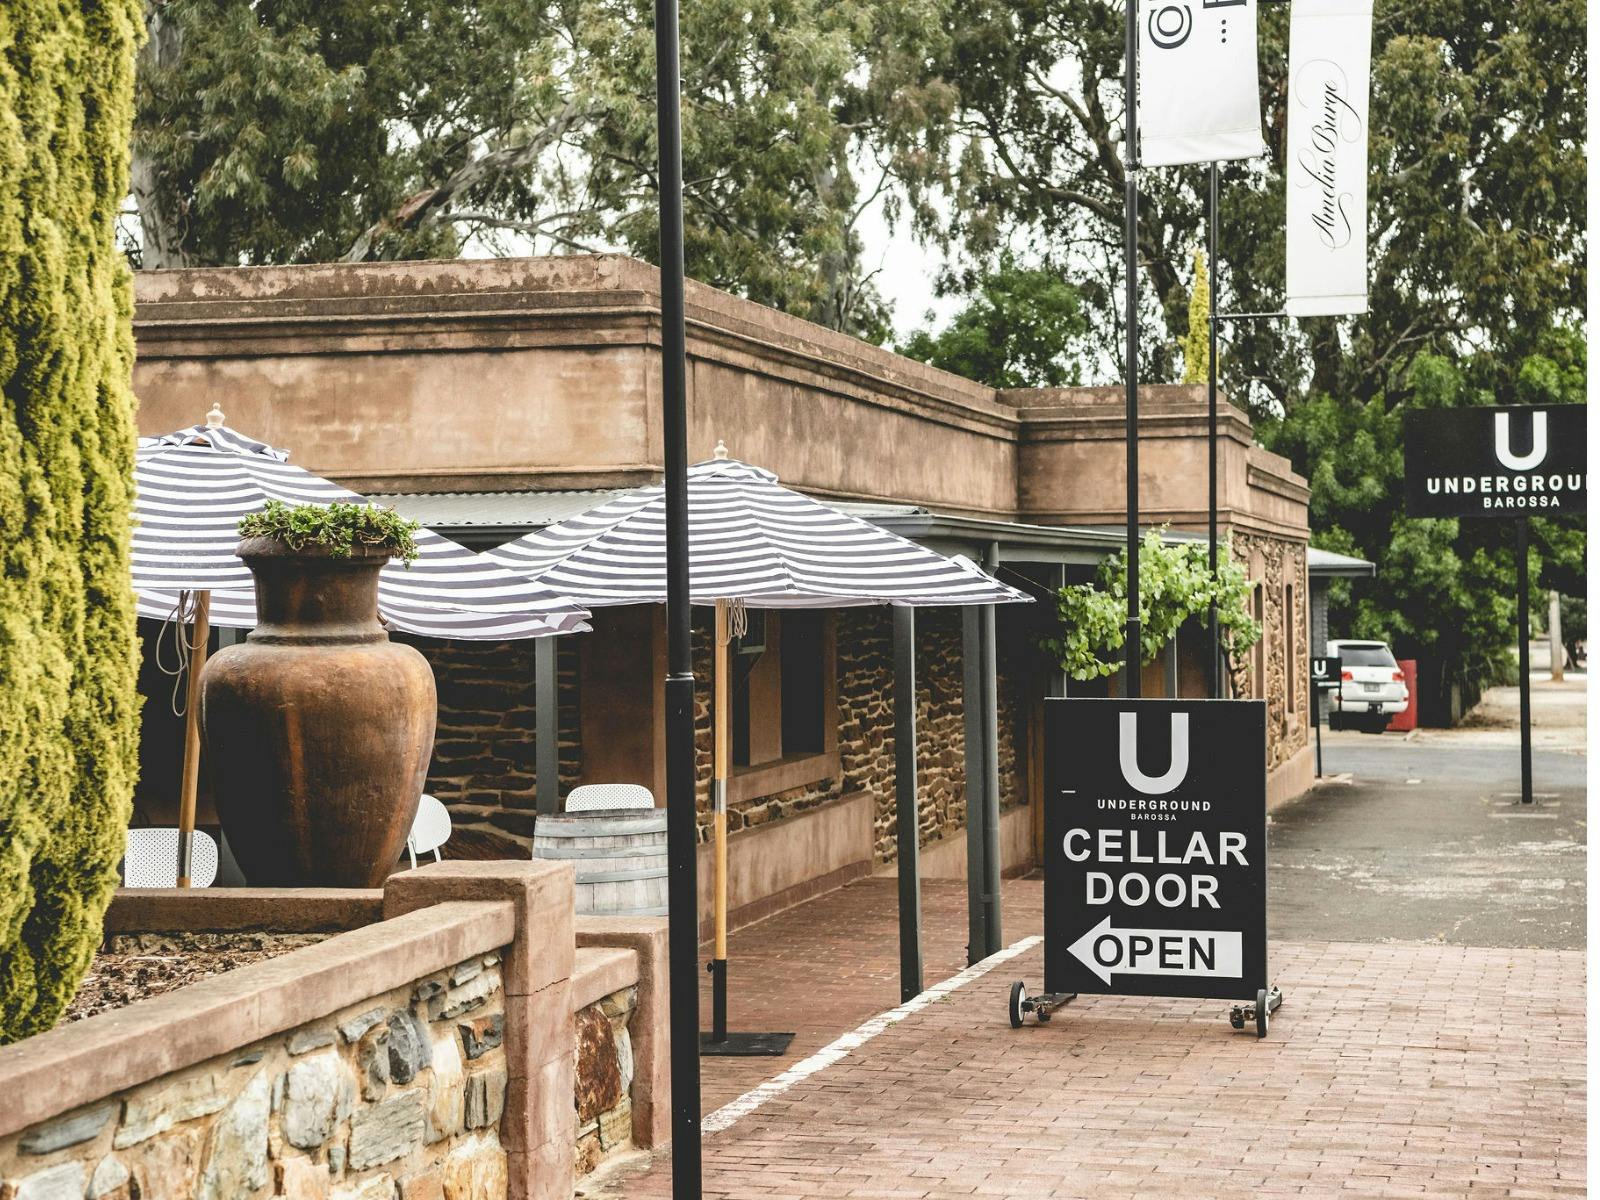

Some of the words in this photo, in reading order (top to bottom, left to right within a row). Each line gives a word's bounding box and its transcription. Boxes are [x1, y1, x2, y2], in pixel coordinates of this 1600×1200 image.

[1296, 59, 1362, 154] Burge
[1296, 148, 1353, 251] Amelia
[1494, 410, 1548, 471] U
[1426, 474, 1587, 494] UNDERGROU
[1483, 495, 1560, 509] BAROSSA
[1314, 660, 1327, 676] U
[1119, 711, 1189, 795] U
[1097, 799, 1211, 812] UNDERGROUND
[1130, 813, 1177, 821] BAROSSA
[1062, 828, 1249, 866] CELLAR
[1086, 871, 1222, 909] DOOR
[1092, 933, 1216, 971] OPEN
